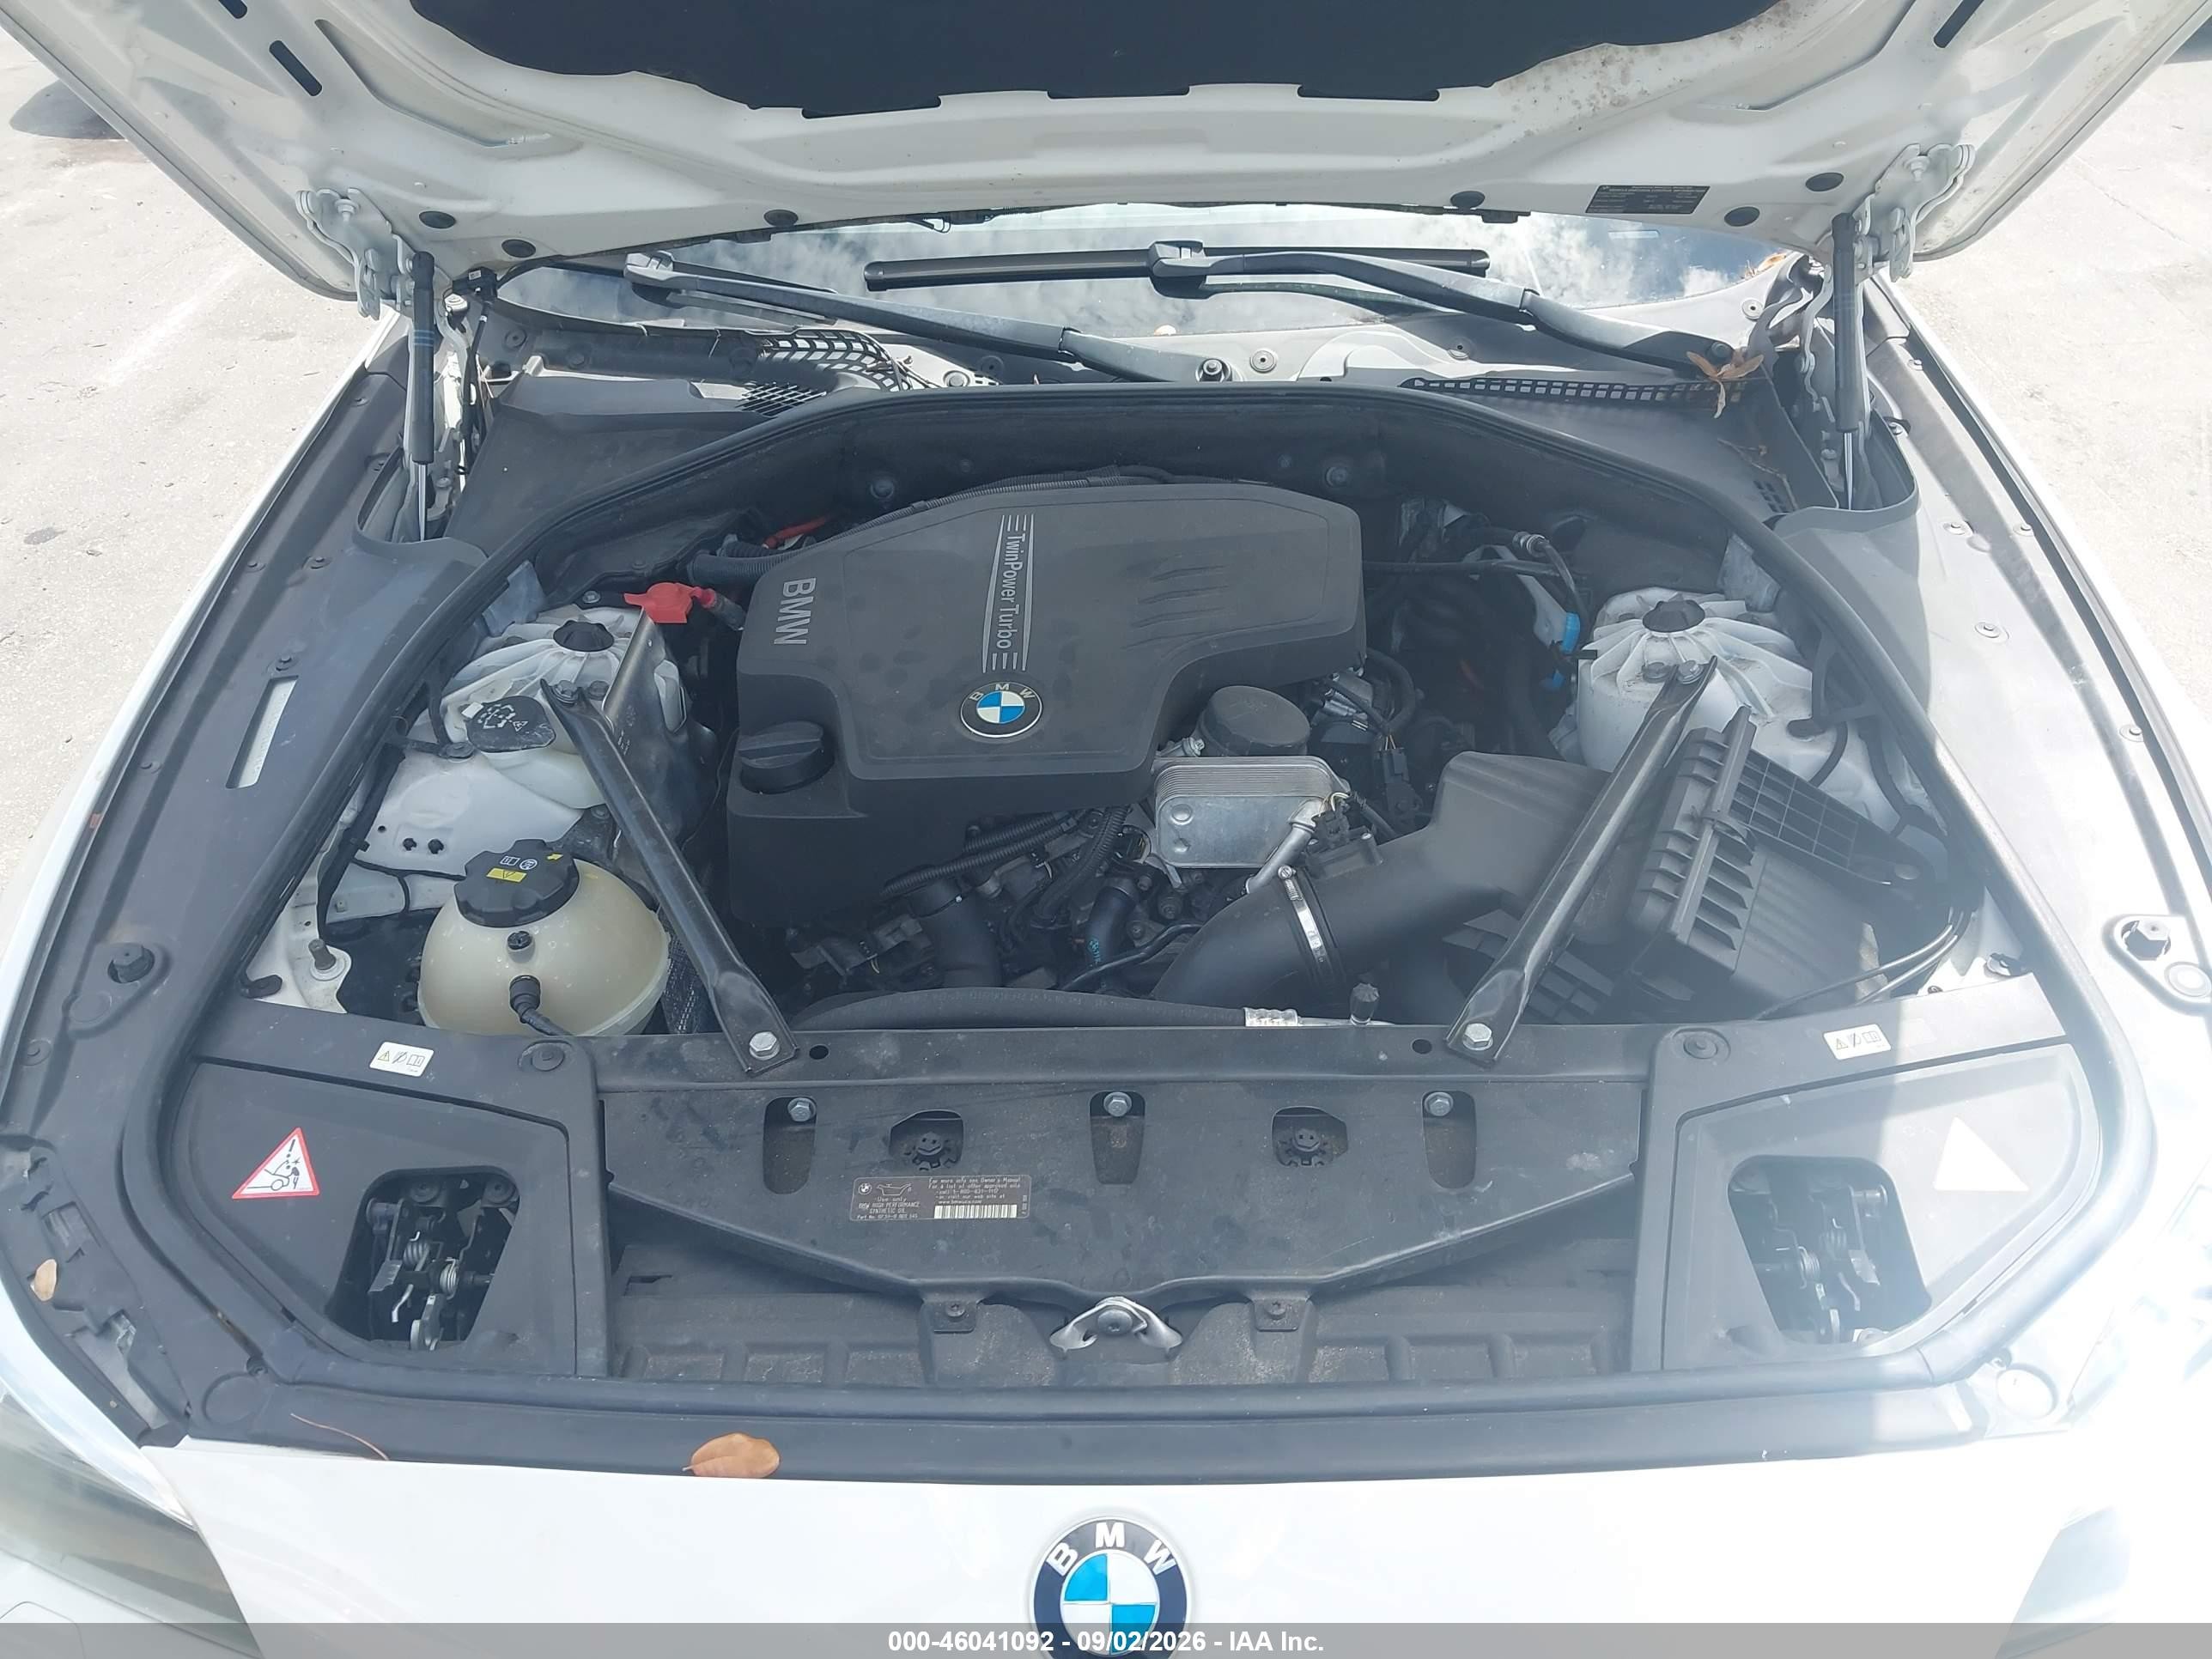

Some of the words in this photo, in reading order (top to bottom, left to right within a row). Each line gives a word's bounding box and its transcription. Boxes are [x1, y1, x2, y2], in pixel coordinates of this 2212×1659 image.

[1000, 532, 1026, 603] TwinPower
[773, 576, 817, 646] BMW
[994, 604, 1020, 650] Turbo
[969, 682, 1036, 702] BMW
[1047, 1522, 1176, 1577] BMW
